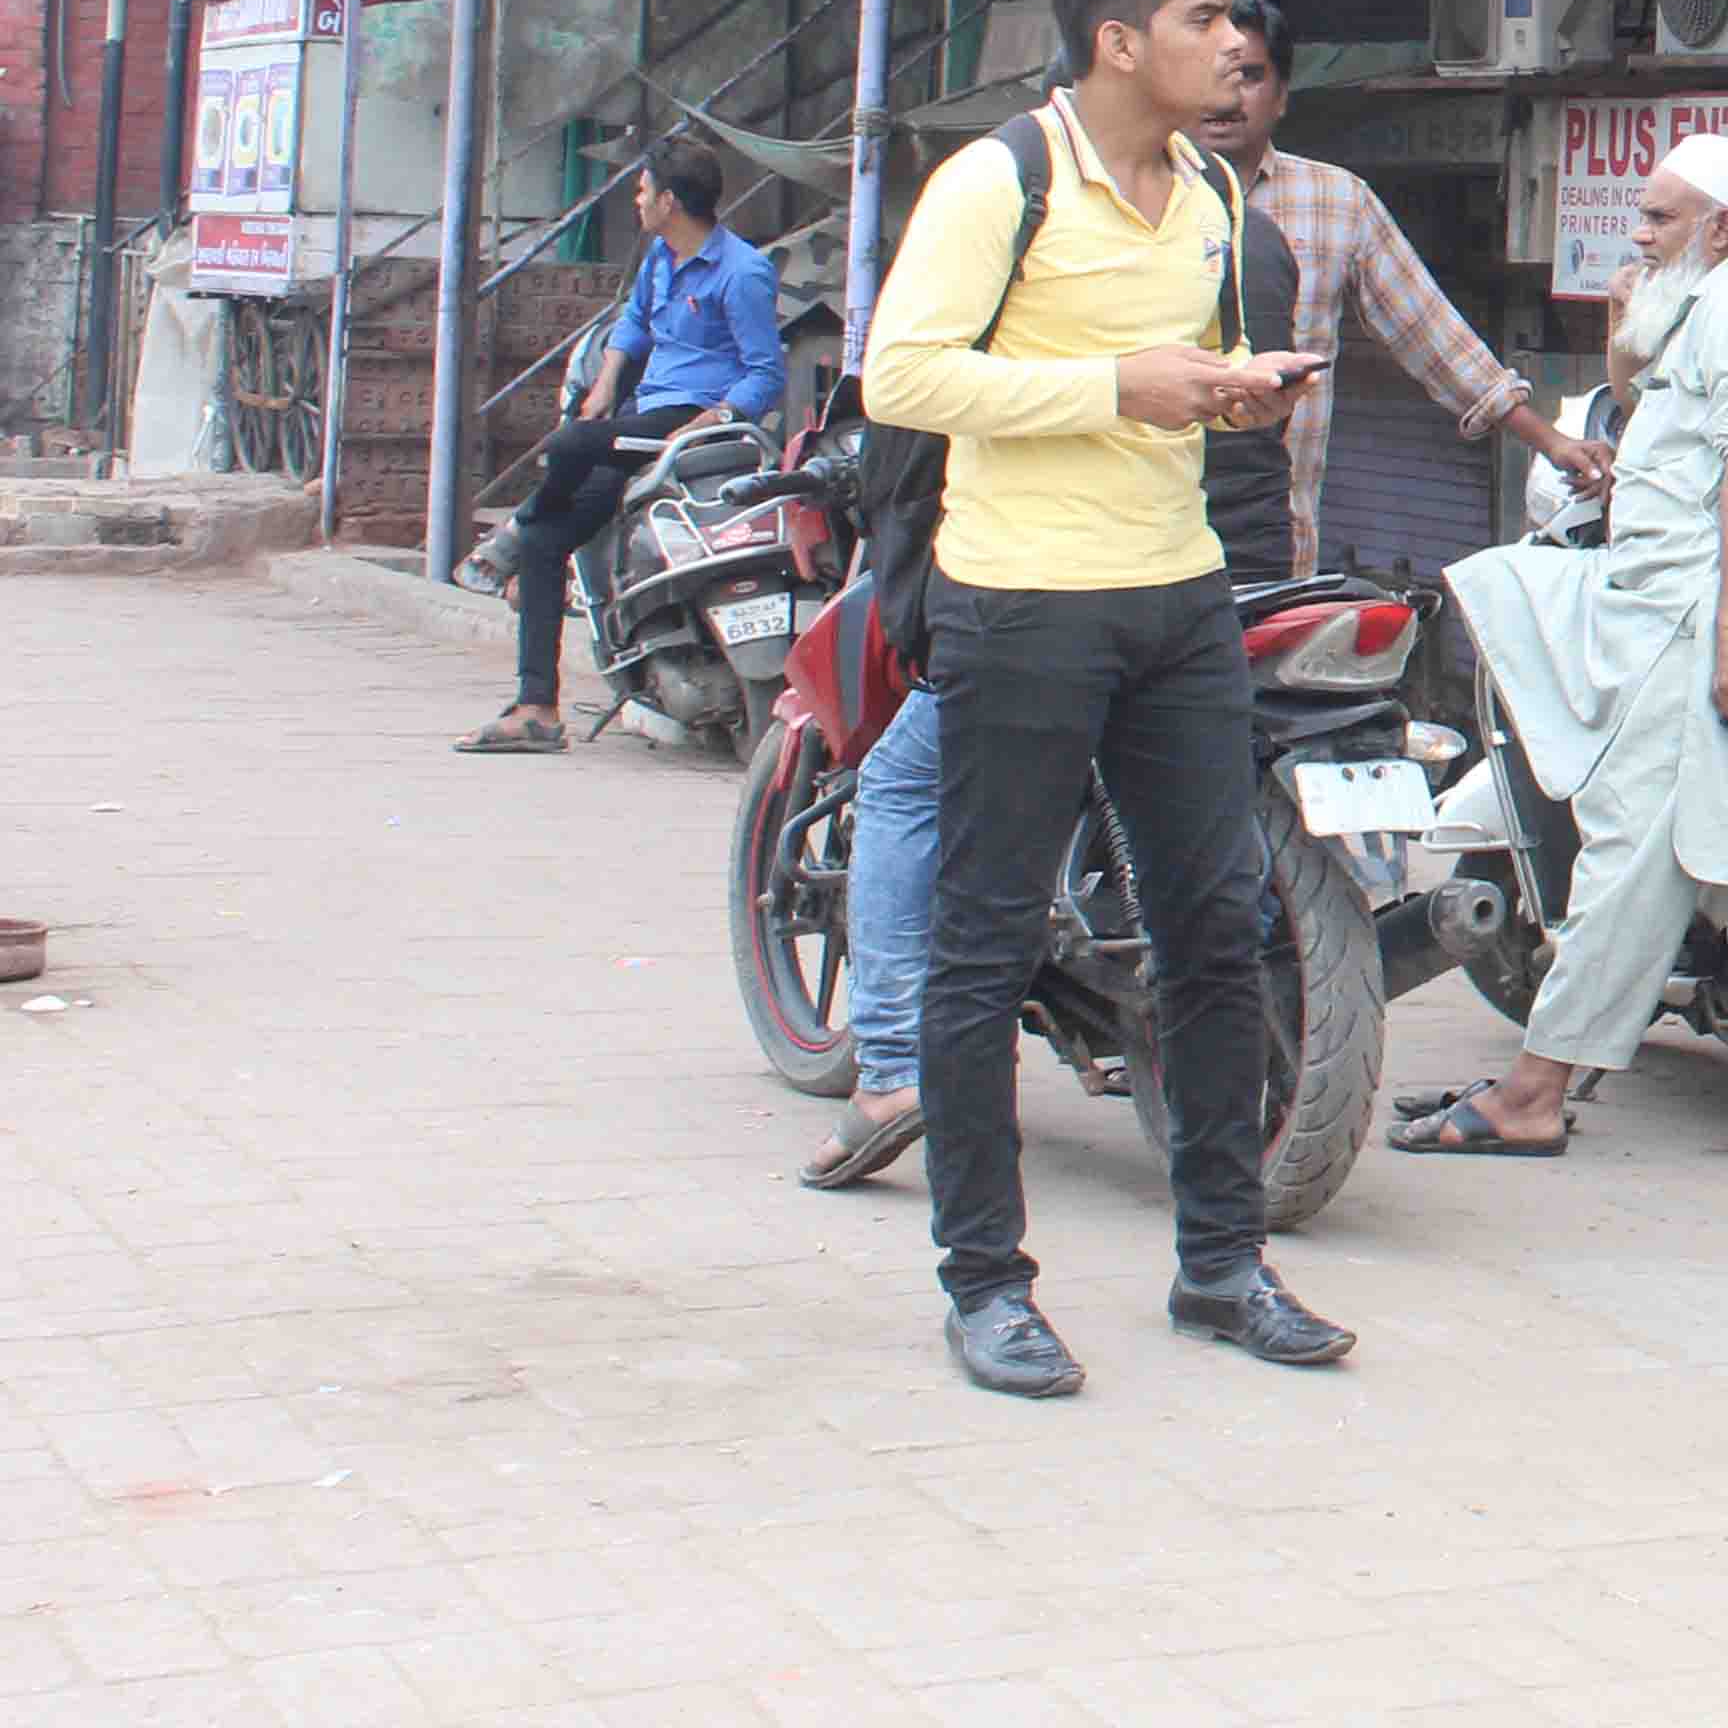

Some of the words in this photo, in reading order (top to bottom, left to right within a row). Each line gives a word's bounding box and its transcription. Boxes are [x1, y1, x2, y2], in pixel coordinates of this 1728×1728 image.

[1563, 106, 1656, 178] PLUS
[1561, 186, 1610, 208] DEALING
[1611, 186, 1624, 207] IN
[1560, 214, 1628, 236] PRINTERS
